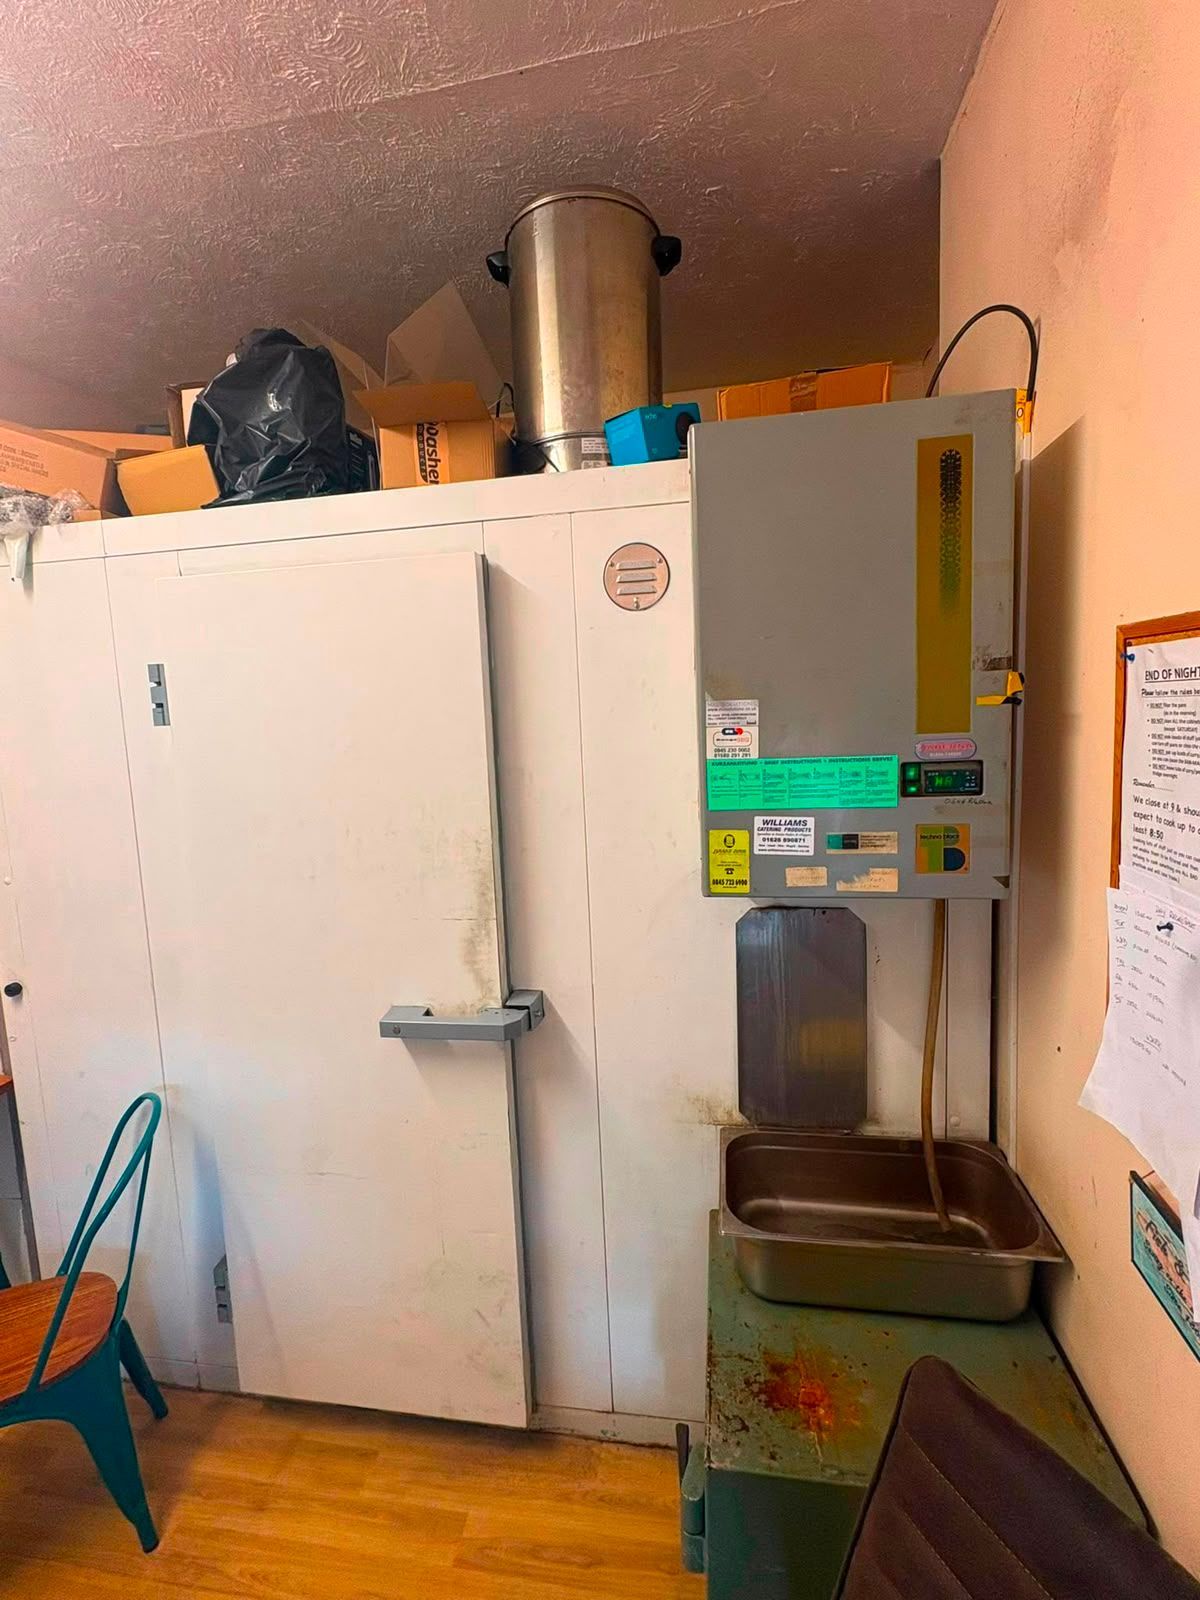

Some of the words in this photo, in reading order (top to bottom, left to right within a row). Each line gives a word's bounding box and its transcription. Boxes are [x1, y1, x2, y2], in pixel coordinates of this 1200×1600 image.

[1145, 670, 1160, 680] END
[1162, 668, 1172, 679] OF
[1133, 795, 1143, 804] We
[1145, 798, 1161, 808] close
[1133, 811, 1153, 822] expect
[1156, 814, 1162, 823] to
[1163, 818, 1175, 827] cook
[1177, 823, 1186, 832] up
[1189, 824, 1195, 833] to
[1133, 824, 1147, 834] least
[1150, 828, 1164, 840] 8:50
